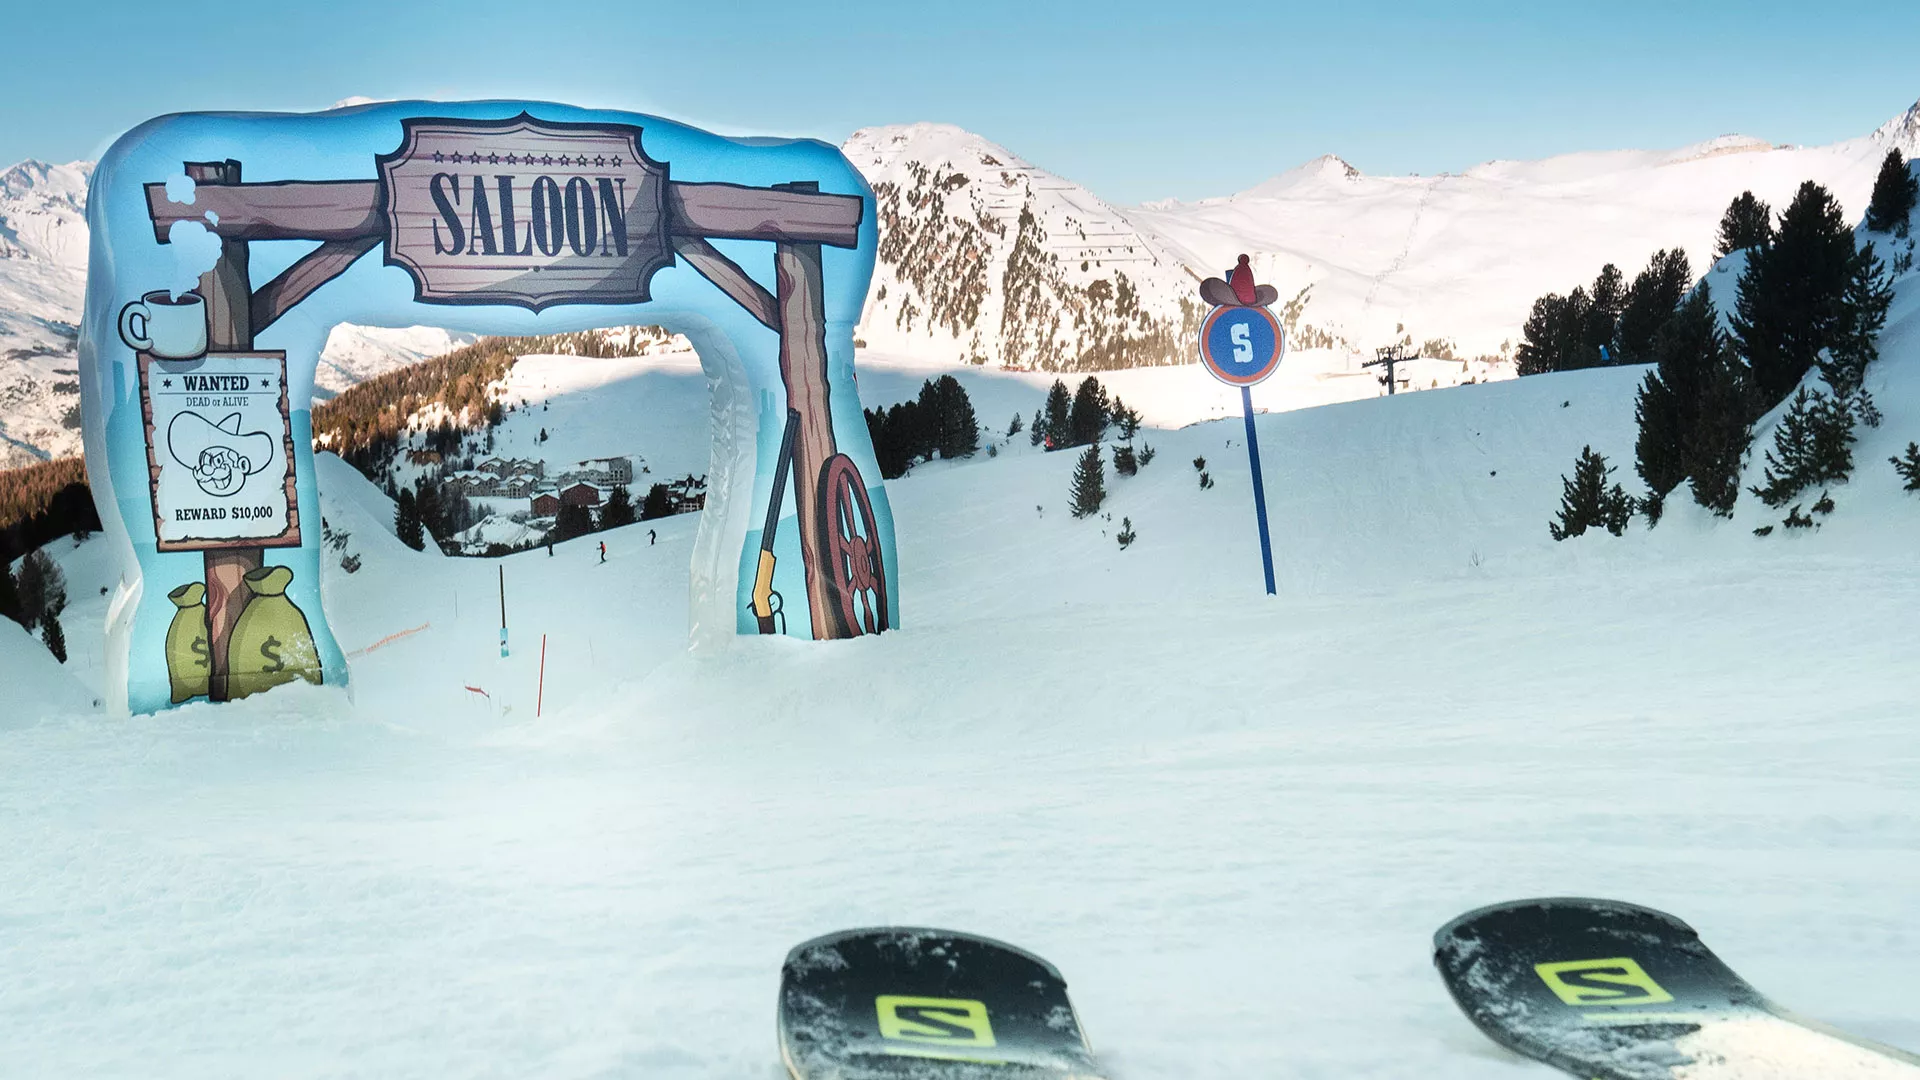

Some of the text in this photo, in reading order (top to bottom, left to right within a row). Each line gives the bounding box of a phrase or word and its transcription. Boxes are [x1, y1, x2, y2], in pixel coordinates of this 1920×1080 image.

[429, 172, 628, 257] SALOON
[1230, 322, 1253, 363] S
[183, 375, 249, 391] WANTED
[186, 397, 249, 407] DEAD or ALIVE
[175, 506, 273, 521] REWARD $10,000
